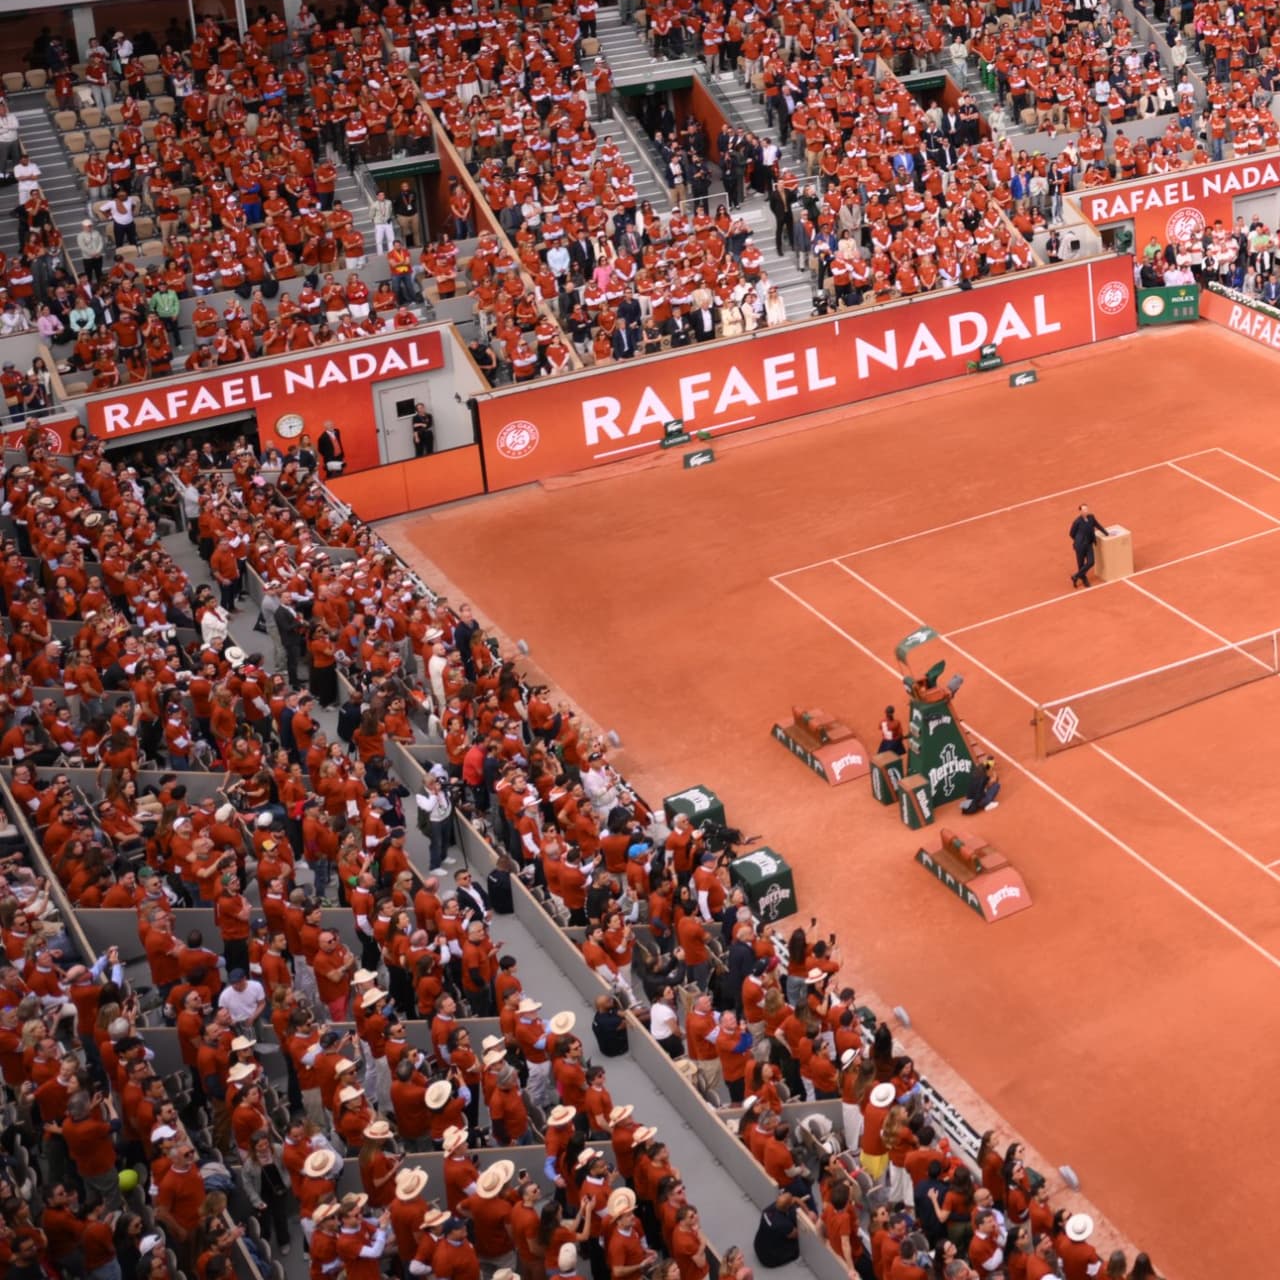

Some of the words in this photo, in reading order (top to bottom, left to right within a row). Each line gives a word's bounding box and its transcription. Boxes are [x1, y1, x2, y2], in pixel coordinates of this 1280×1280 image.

[1092, 180, 1195, 222] RAFAEL
[1171, 295, 1194, 303] ROLEX
[103, 374, 273, 433] RAFAEL
[284, 341, 430, 395] NADAL
[582, 345, 838, 446] RAFAEL
[856, 293, 1062, 380] NADAL
